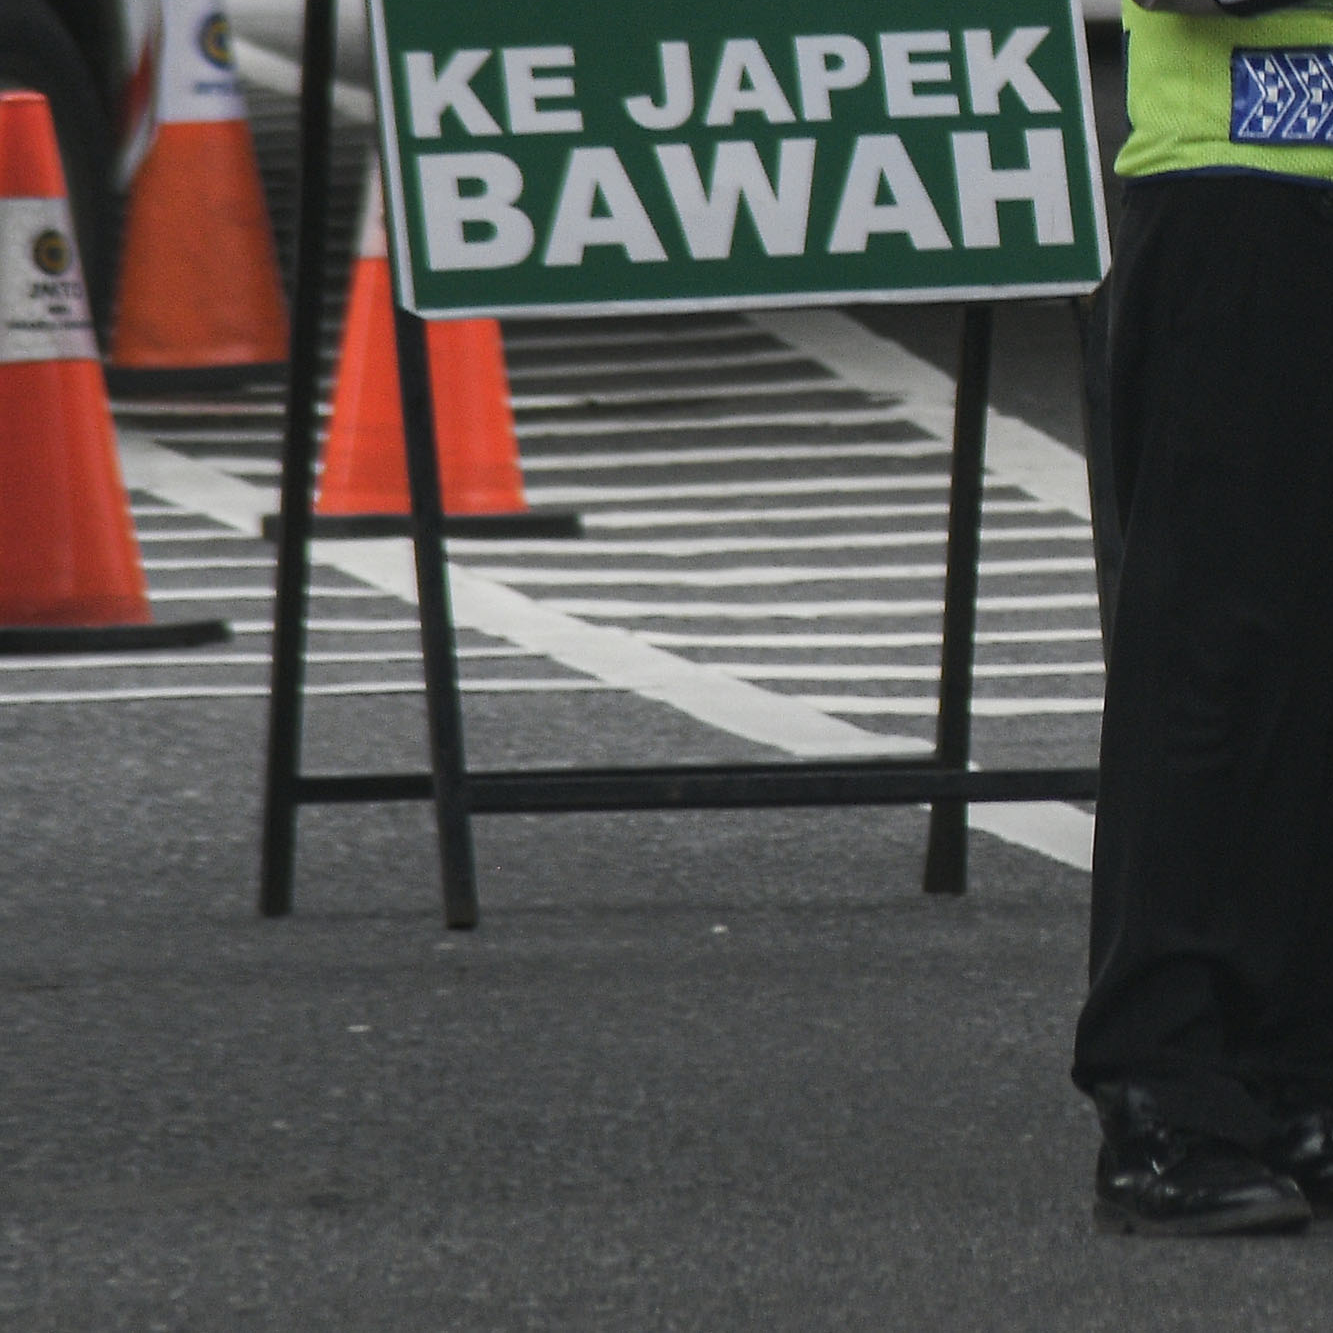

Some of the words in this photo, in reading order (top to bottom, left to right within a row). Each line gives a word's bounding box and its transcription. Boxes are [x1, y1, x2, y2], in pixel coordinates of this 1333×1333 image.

[404, 45, 585, 139] KE
[625, 26, 1062, 131] JAPEK
[415, 127, 1076, 272] BAWAH
